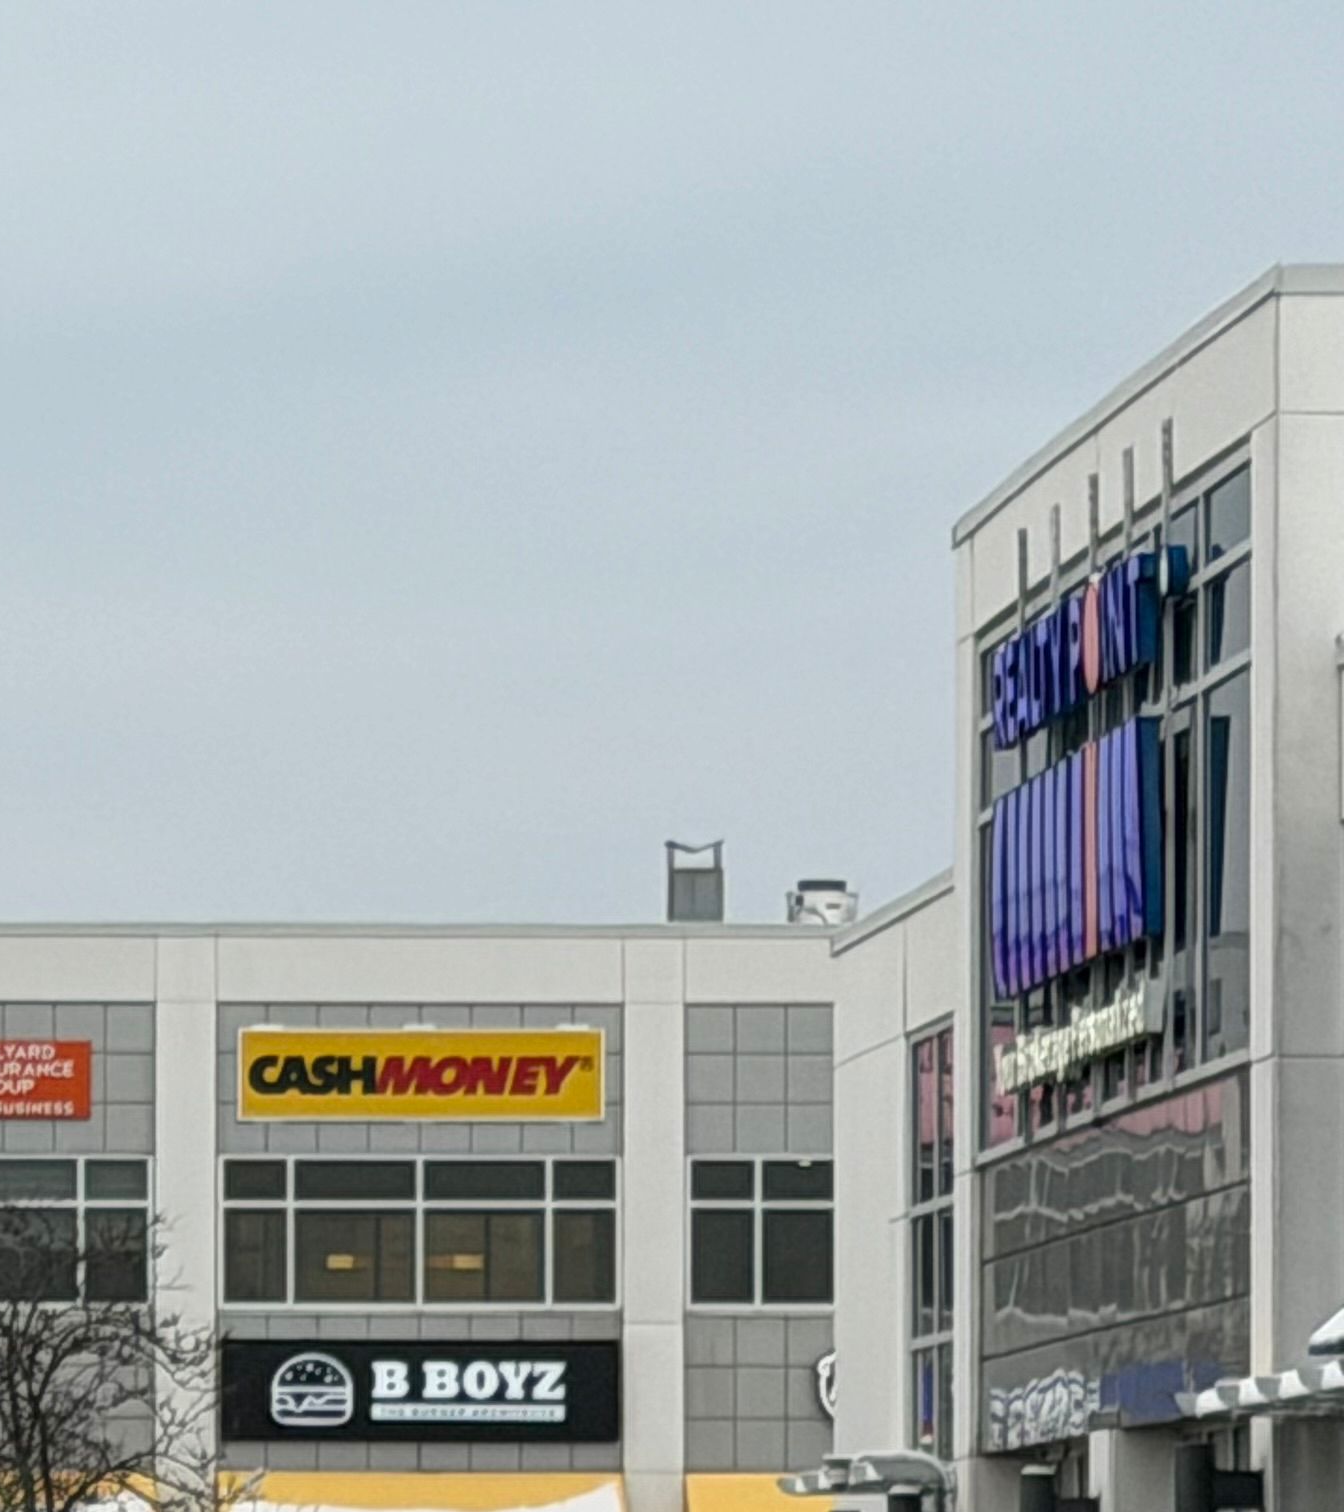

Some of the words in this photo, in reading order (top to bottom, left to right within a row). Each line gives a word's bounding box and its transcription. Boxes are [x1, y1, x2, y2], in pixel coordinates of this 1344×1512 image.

[1069, 556, 1141, 706] POINT
[370, 1360, 410, 1400] B
[422, 1360, 567, 1401] BOYZ
